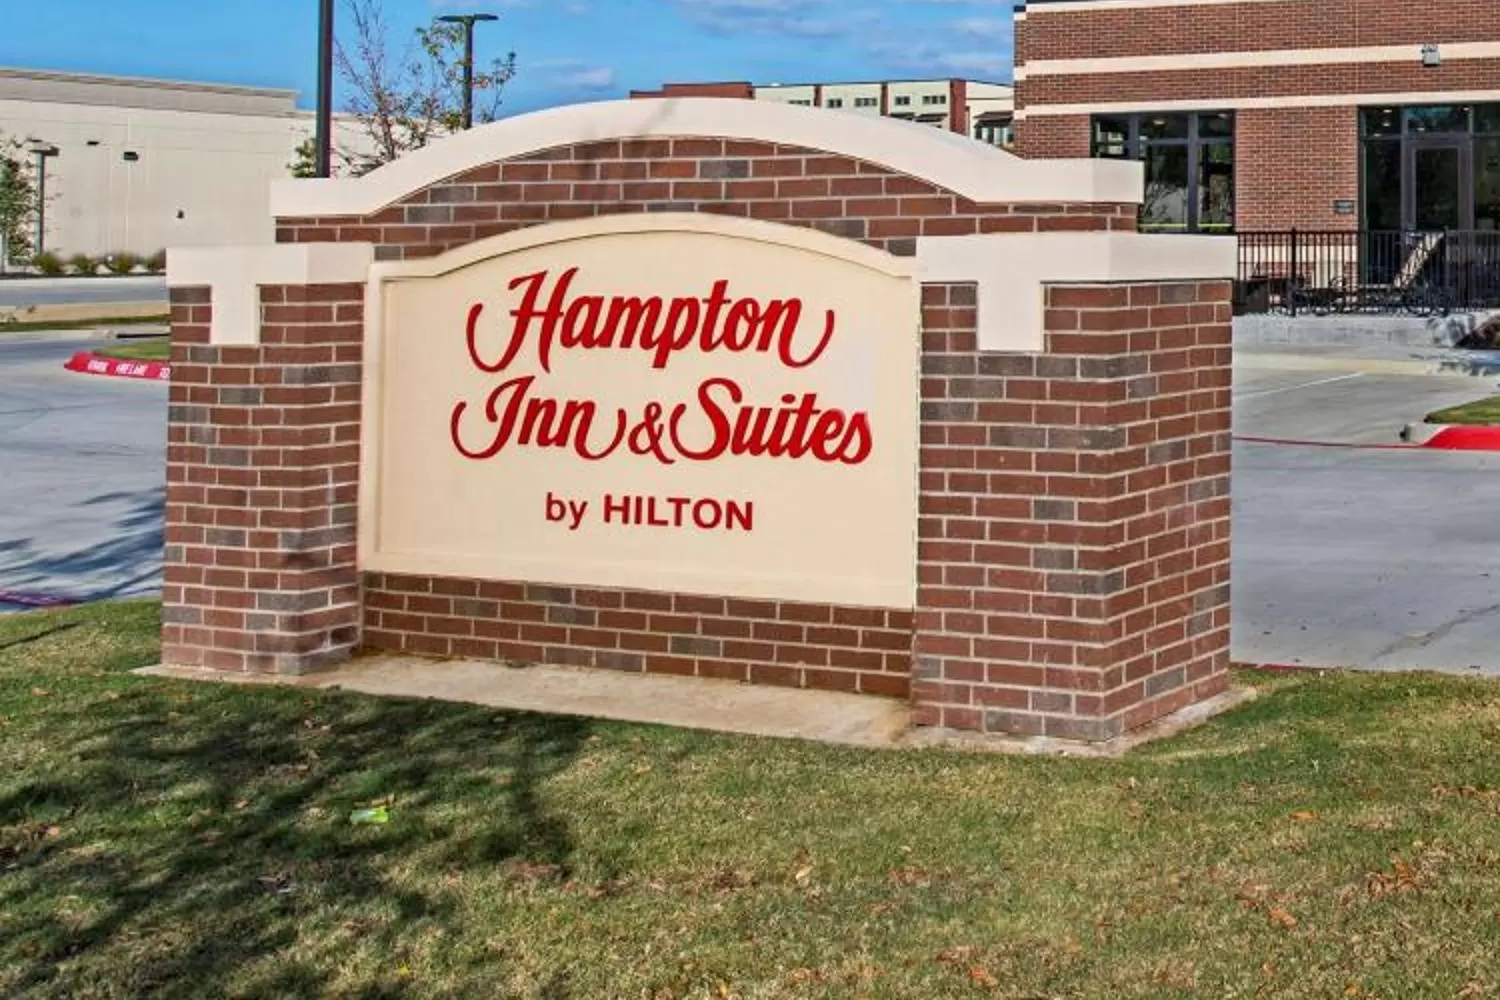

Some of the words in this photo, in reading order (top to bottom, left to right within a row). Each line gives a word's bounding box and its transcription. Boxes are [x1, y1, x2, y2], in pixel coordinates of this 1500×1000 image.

[466, 266, 836, 374] Hampton
[450, 375, 627, 461] Inn
[626, 401, 675, 465] &
[668, 377, 873, 466] Suites
[545, 493, 588, 530] by
[602, 494, 754, 531] HILTON
